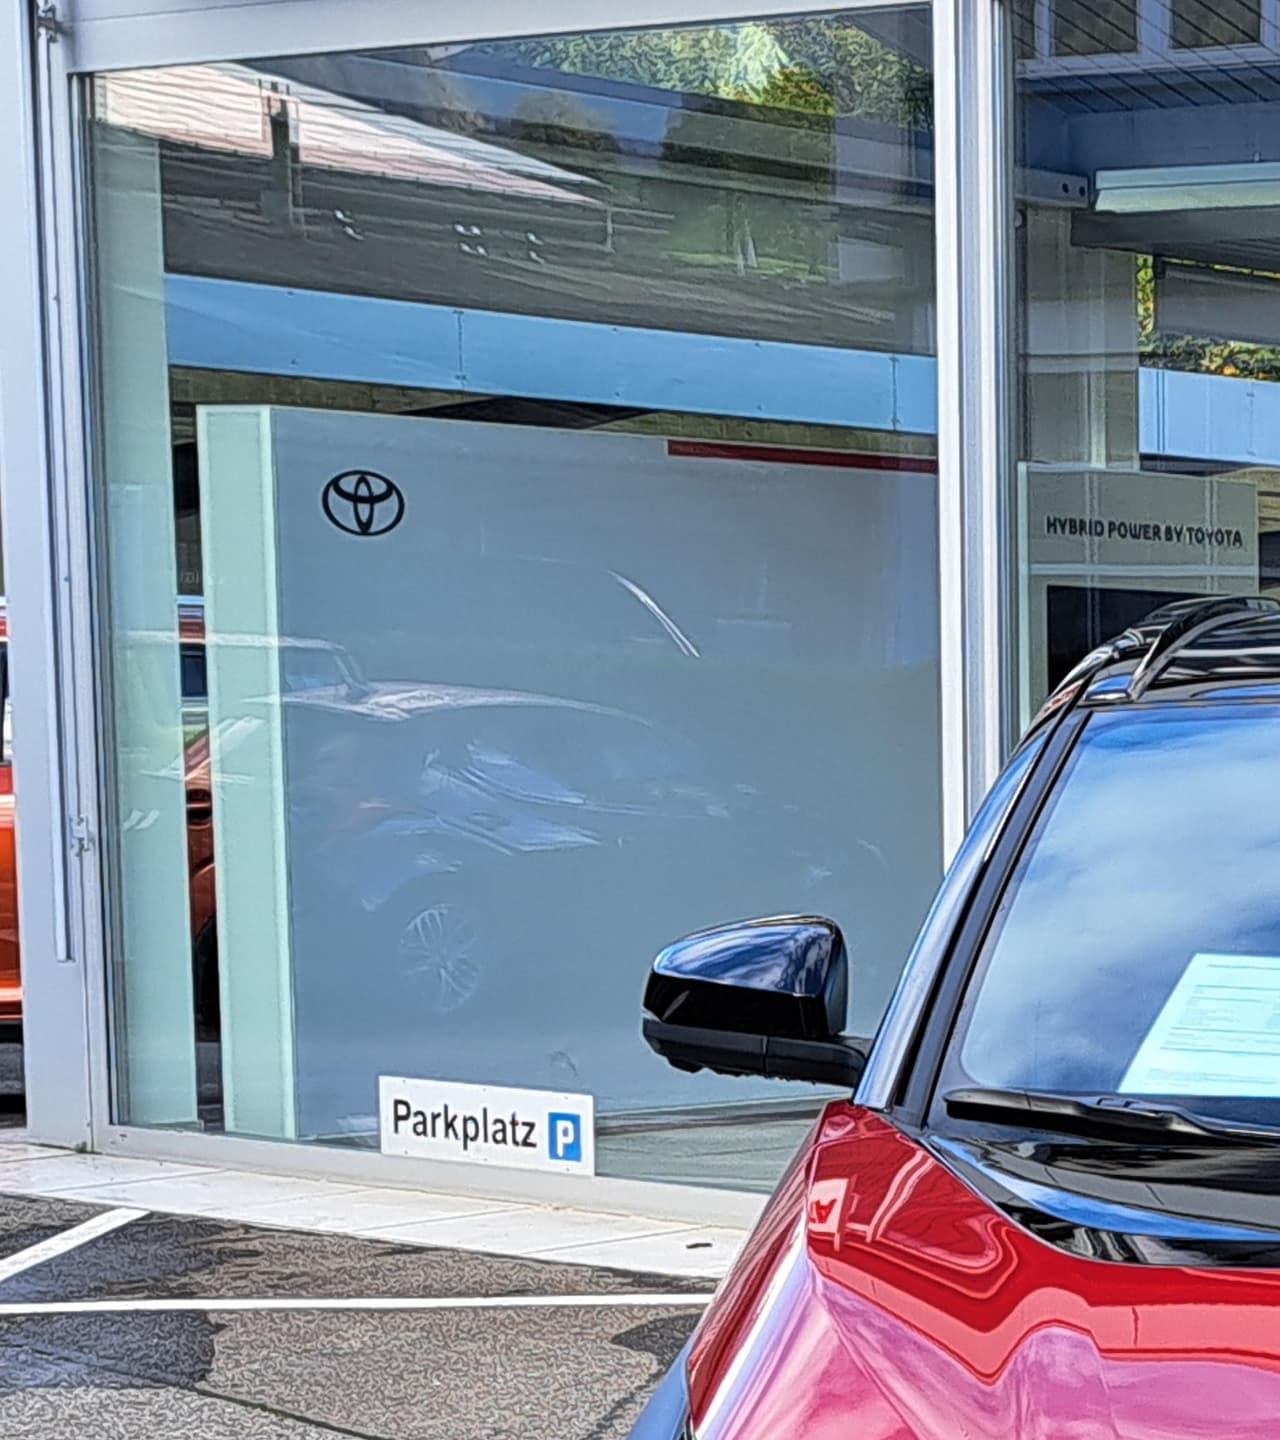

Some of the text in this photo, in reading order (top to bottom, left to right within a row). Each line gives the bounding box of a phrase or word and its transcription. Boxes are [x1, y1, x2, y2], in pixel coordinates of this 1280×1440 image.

[1046, 515, 1243, 547] HYBRID POWER BY TOYOTA
[393, 1098, 537, 1151] Parkplatz
